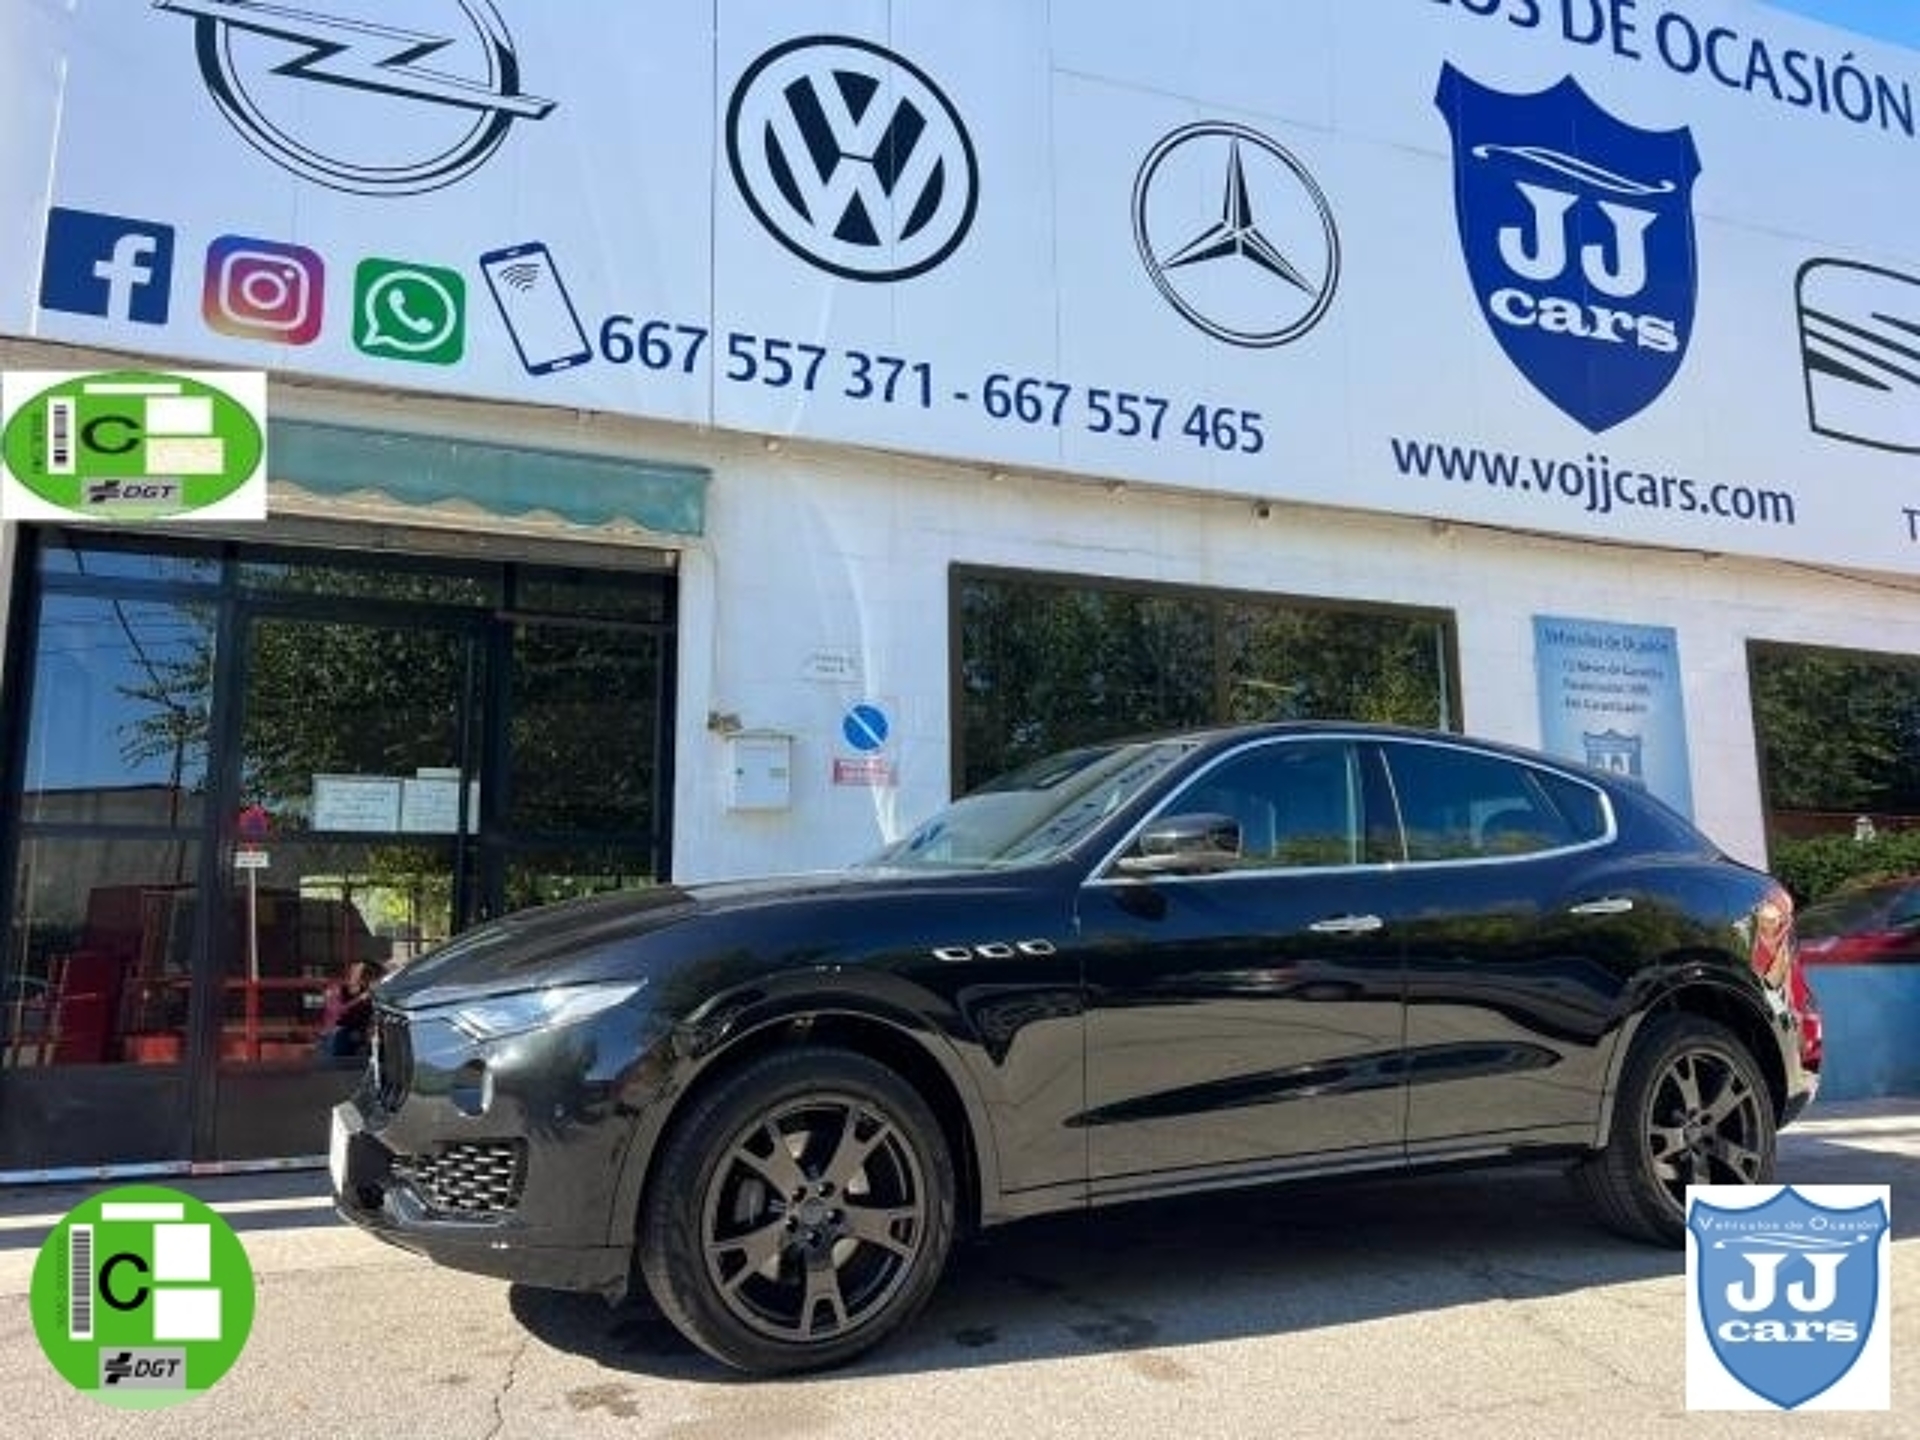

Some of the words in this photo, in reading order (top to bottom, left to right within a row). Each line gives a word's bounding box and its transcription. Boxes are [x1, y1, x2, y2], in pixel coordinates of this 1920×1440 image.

[1561, 0, 1641, 60] DE
[1654, 13, 1915, 137] OCASIÓN
[1498, 180, 1658, 298] JJ
[1489, 287, 1679, 353] cars
[599, 314, 709, 373] 667
[727, 332, 827, 391] 557
[844, 350, 931, 408] 371
[983, 374, 1072, 427] 667
[1087, 388, 1169, 441] 557
[1182, 404, 1264, 454] 465
[1391, 437, 1796, 525] www.vojjcars.com
